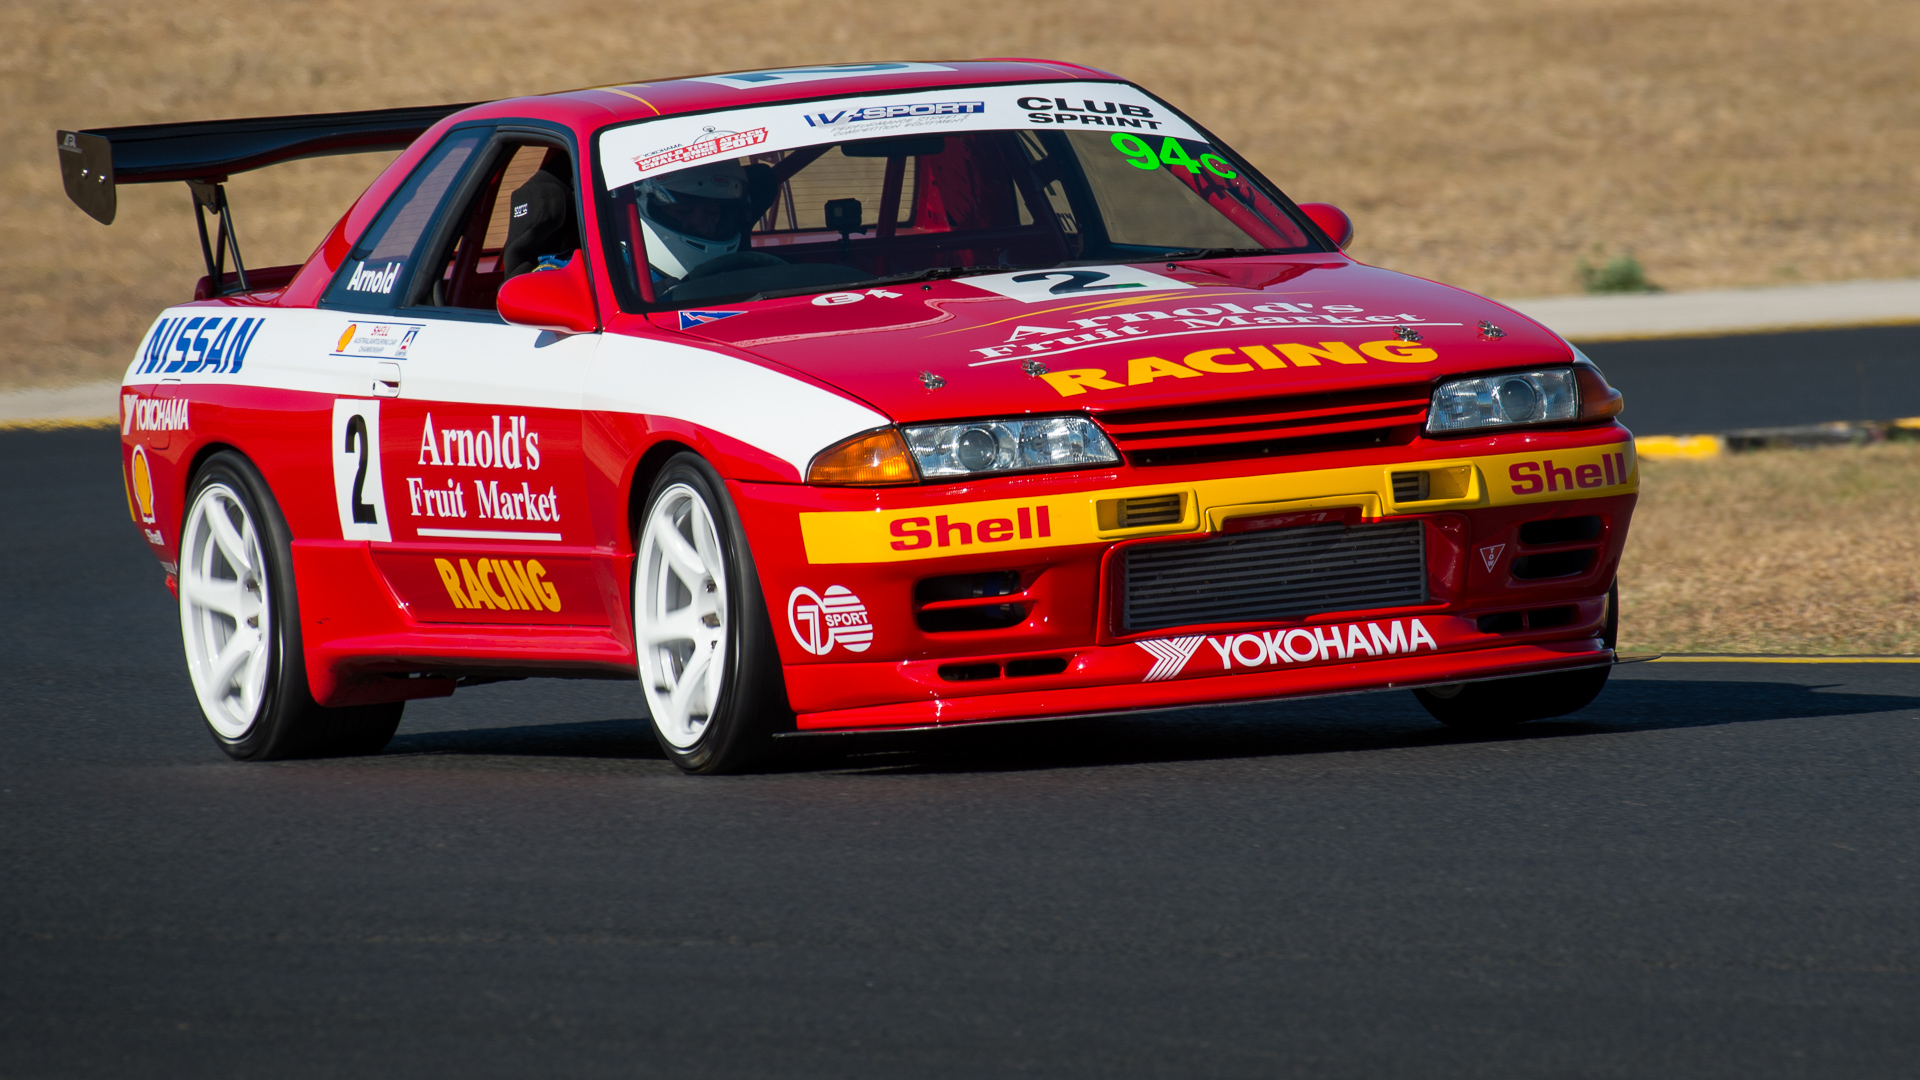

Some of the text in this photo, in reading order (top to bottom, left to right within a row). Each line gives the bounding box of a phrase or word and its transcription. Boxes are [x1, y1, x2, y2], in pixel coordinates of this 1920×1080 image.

[904, 118, 968, 128] EQUIPMENT
[1016, 97, 1154, 118] CLUB
[1027, 113, 1162, 130] SPRINT
[639, 128, 764, 165] WORLD TIME ATTACK
[641, 133, 764, 170] CHALLENGE 2017
[643, 143, 683, 158] YOKOHAMA
[346, 260, 401, 294] Arnold
[1012, 270, 1148, 295] 2
[371, 326, 390, 336] SHELL
[969, 312, 1426, 359] Fruit Market
[1003, 302, 1364, 343] Arnold's
[135, 316, 267, 375] NISSAN
[1039, 340, 1439, 398] RACING
[136, 398, 189, 431] YOKOHAMA
[418, 412, 540, 471] Arnold's
[345, 414, 378, 524] 2
[1508, 452, 1627, 495] Shell
[406, 477, 560, 522] Fruit Market
[889, 505, 1051, 551] Shell
[434, 557, 562, 613] RACING
[825, 611, 868, 627] SPORT
[1207, 618, 1438, 670] YOKOHAMA
